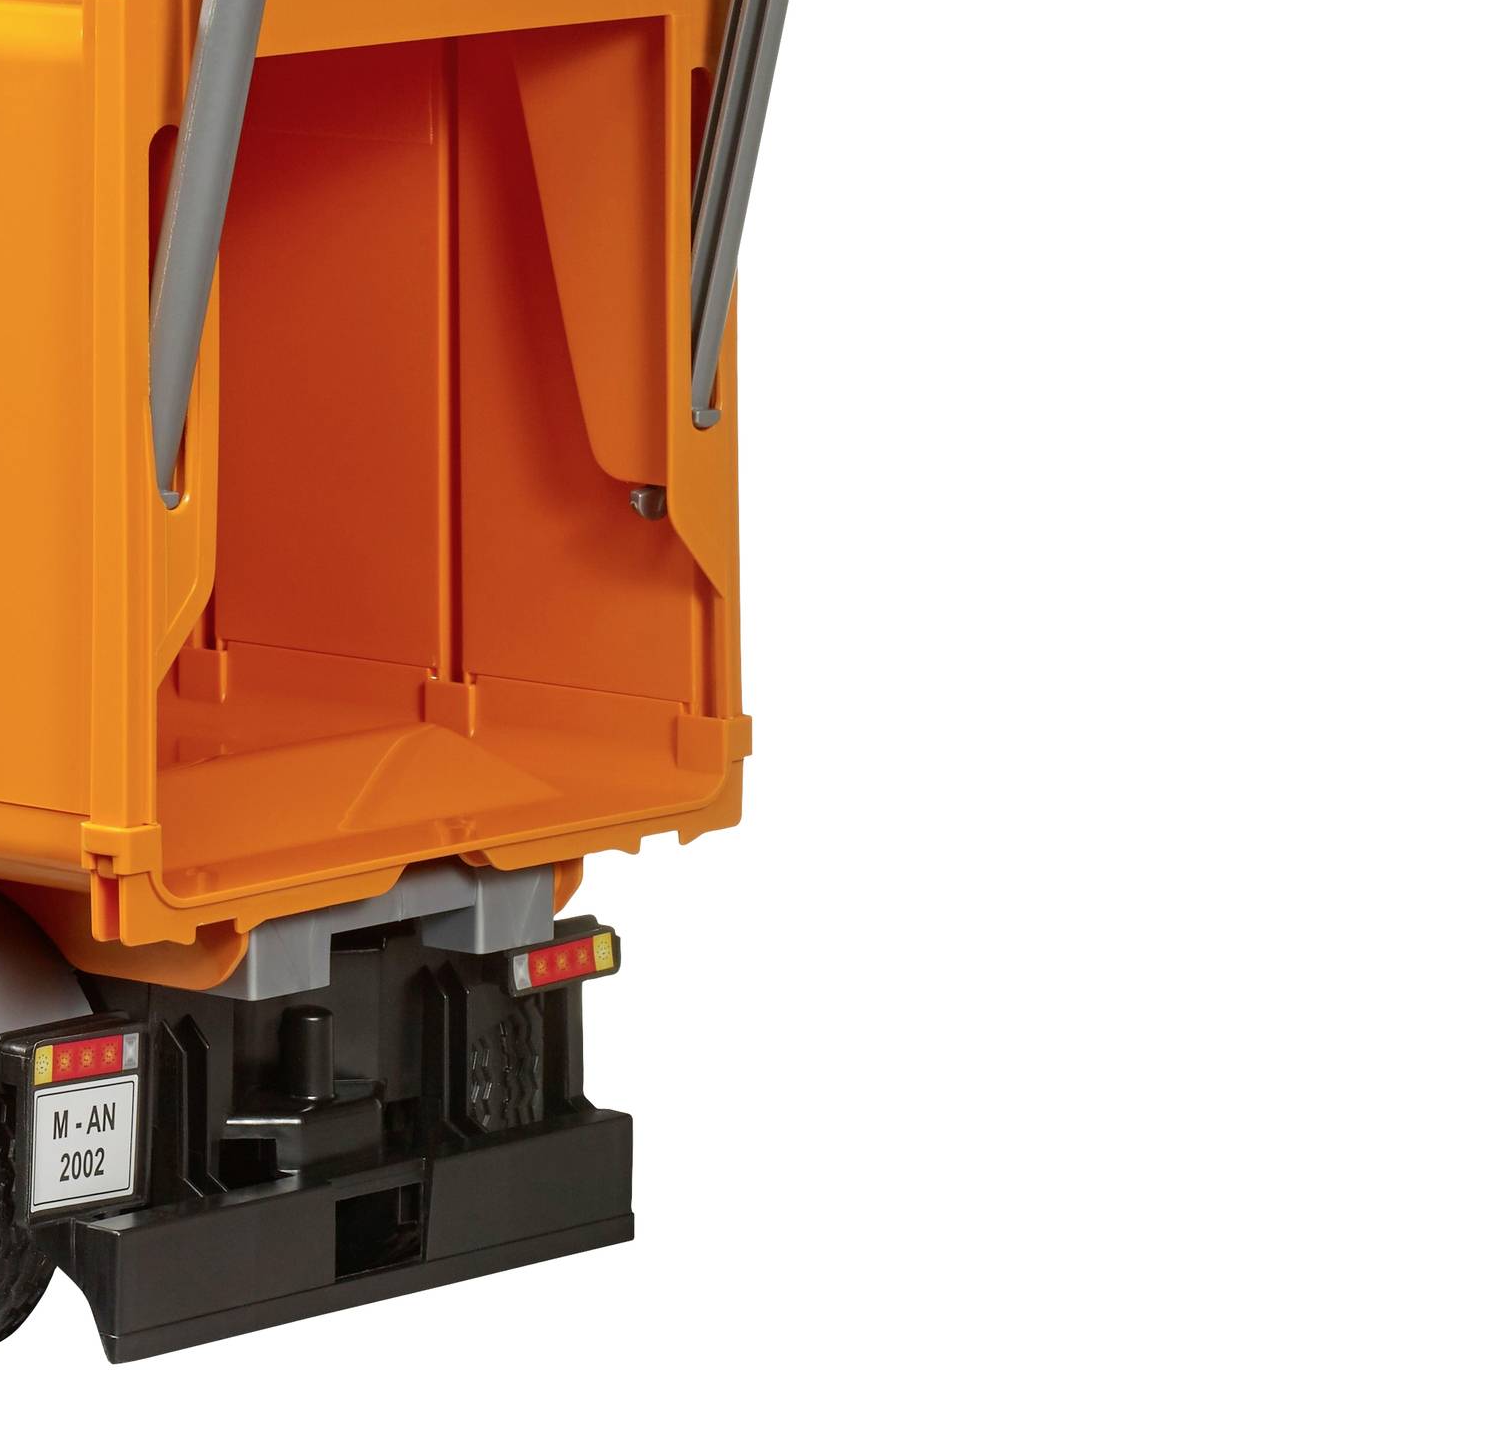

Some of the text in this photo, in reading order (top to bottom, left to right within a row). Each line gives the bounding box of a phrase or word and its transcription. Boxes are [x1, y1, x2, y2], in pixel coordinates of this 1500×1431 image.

[52, 1109, 69, 1140] M
[86, 1102, 116, 1135] AN
[59, 1147, 105, 1183] 2002
